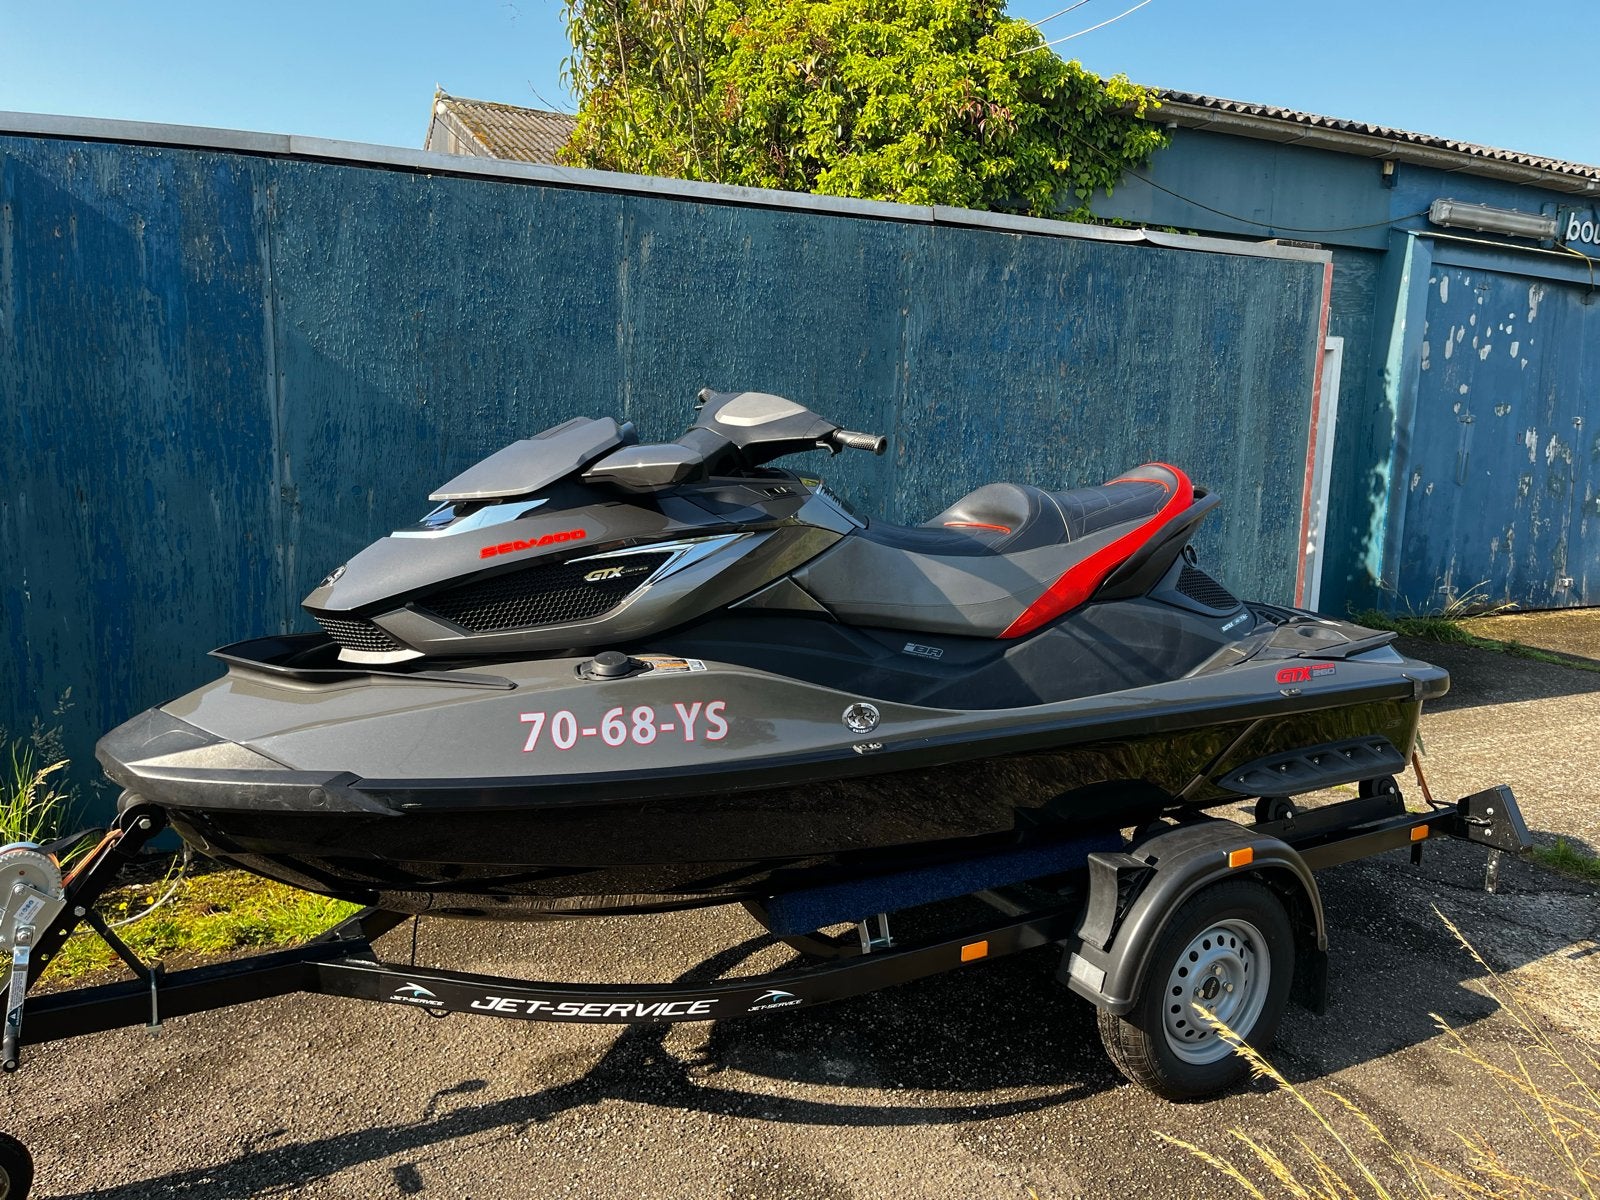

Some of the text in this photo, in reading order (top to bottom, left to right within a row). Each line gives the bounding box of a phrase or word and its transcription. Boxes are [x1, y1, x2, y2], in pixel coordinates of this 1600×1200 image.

[583, 566, 625, 582] GTX
[1276, 665, 1312, 684] GTX
[520, 700, 729, 752] 70-68-YS
[390, 995, 445, 1006] JET-SERVICE
[471, 996, 719, 1018] JET-SERVICE
[747, 998, 804, 1012] JET-SERVICE
